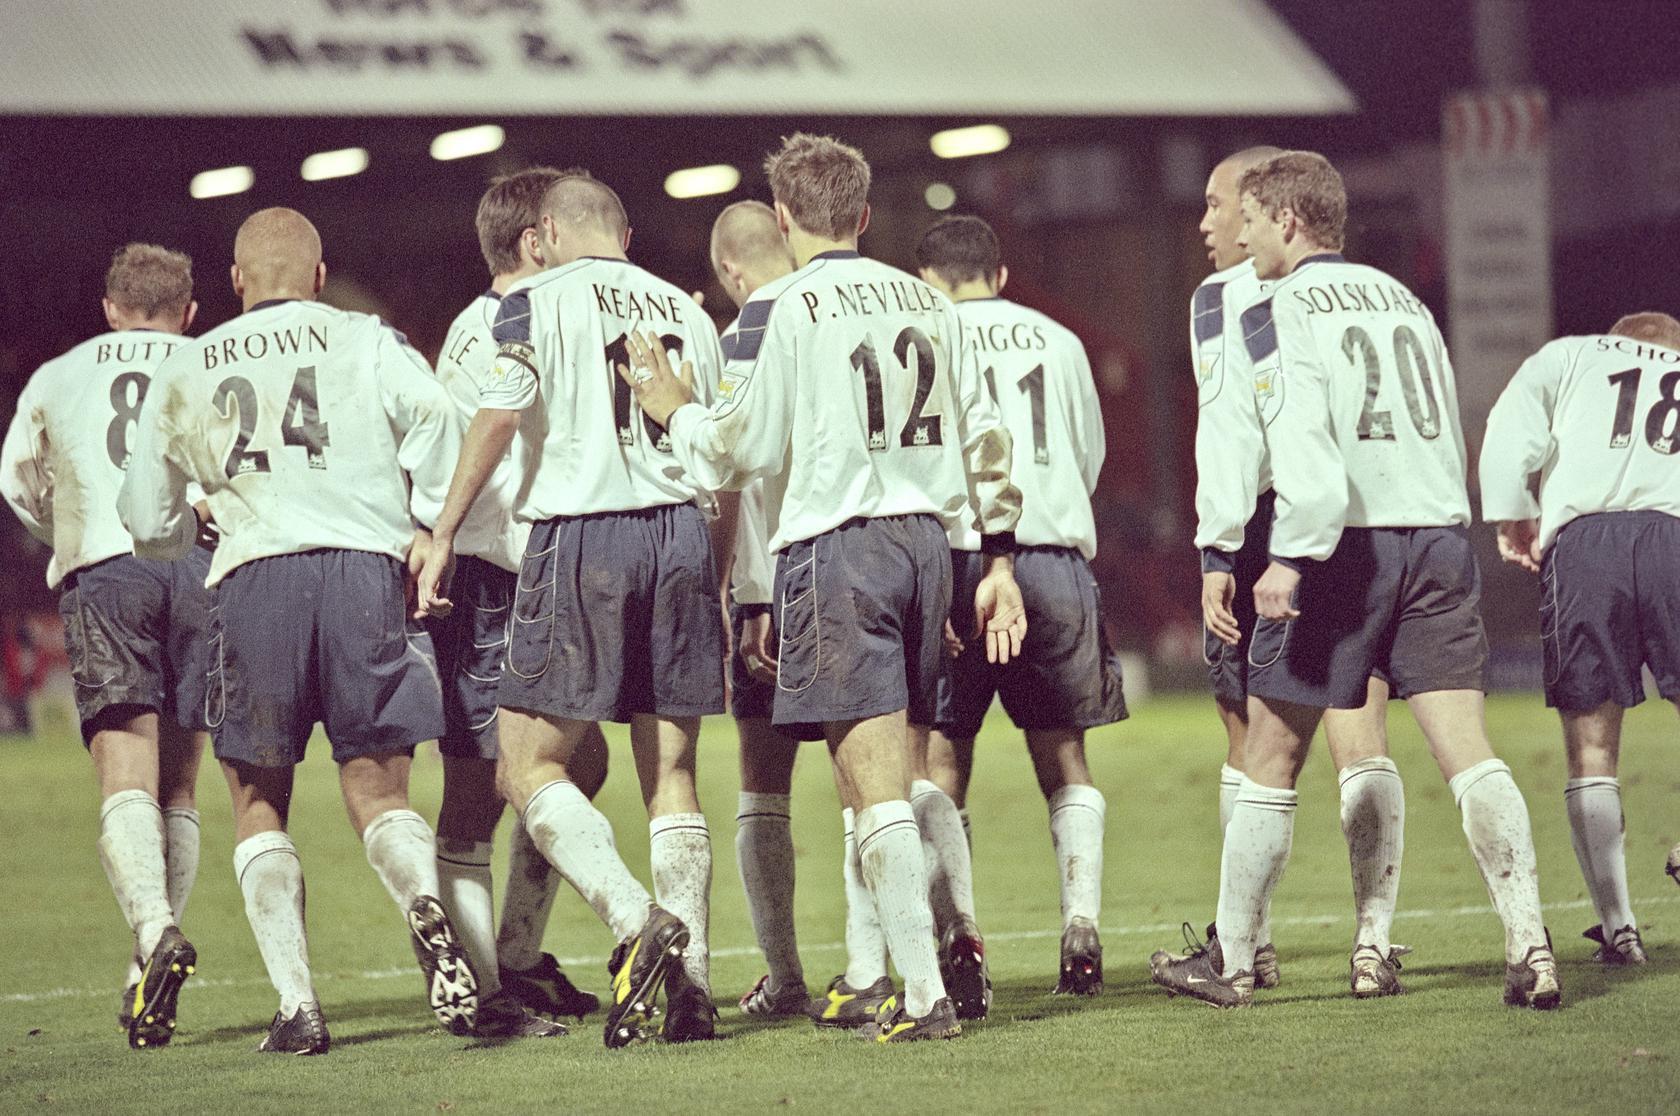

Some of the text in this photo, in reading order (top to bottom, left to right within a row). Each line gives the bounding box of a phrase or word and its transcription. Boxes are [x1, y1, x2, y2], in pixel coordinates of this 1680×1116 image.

[592, 283, 683, 324] KEANE
[801, 281, 943, 323] P.NEVILLE
[96, 341, 178, 364] BUTT
[203, 325, 328, 369] BROWN
[1597, 338, 1680, 364] SCHO
[850, 326, 943, 451] 12
[1341, 325, 1441, 441] 20
[1608, 367, 1680, 455] 18
[106, 371, 151, 472] 8
[212, 365, 330, 480] 24
